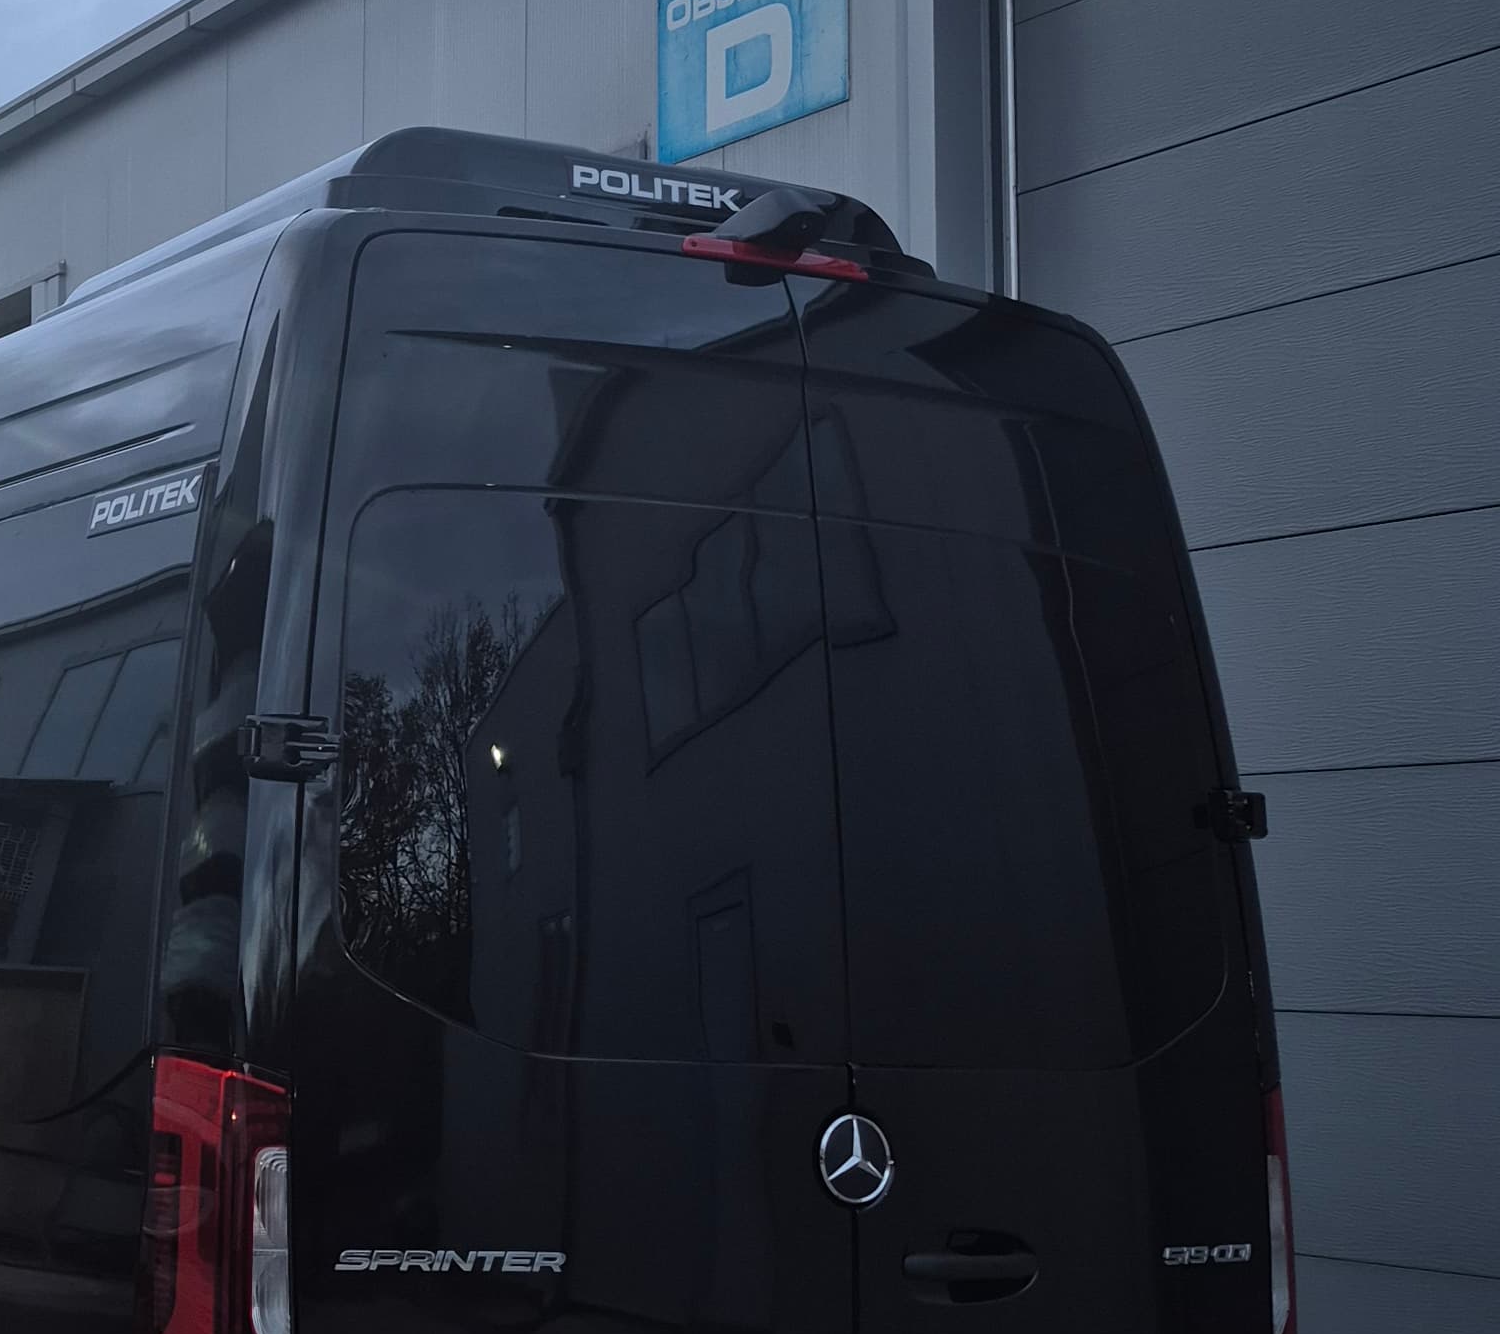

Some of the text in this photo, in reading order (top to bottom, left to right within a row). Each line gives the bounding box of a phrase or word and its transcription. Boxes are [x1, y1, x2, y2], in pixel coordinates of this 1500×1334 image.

[705, 2, 793, 134] D
[572, 164, 742, 213] POLITEK
[90, 474, 202, 530] POLITEK
[333, 1248, 568, 1274] SPRINTER
